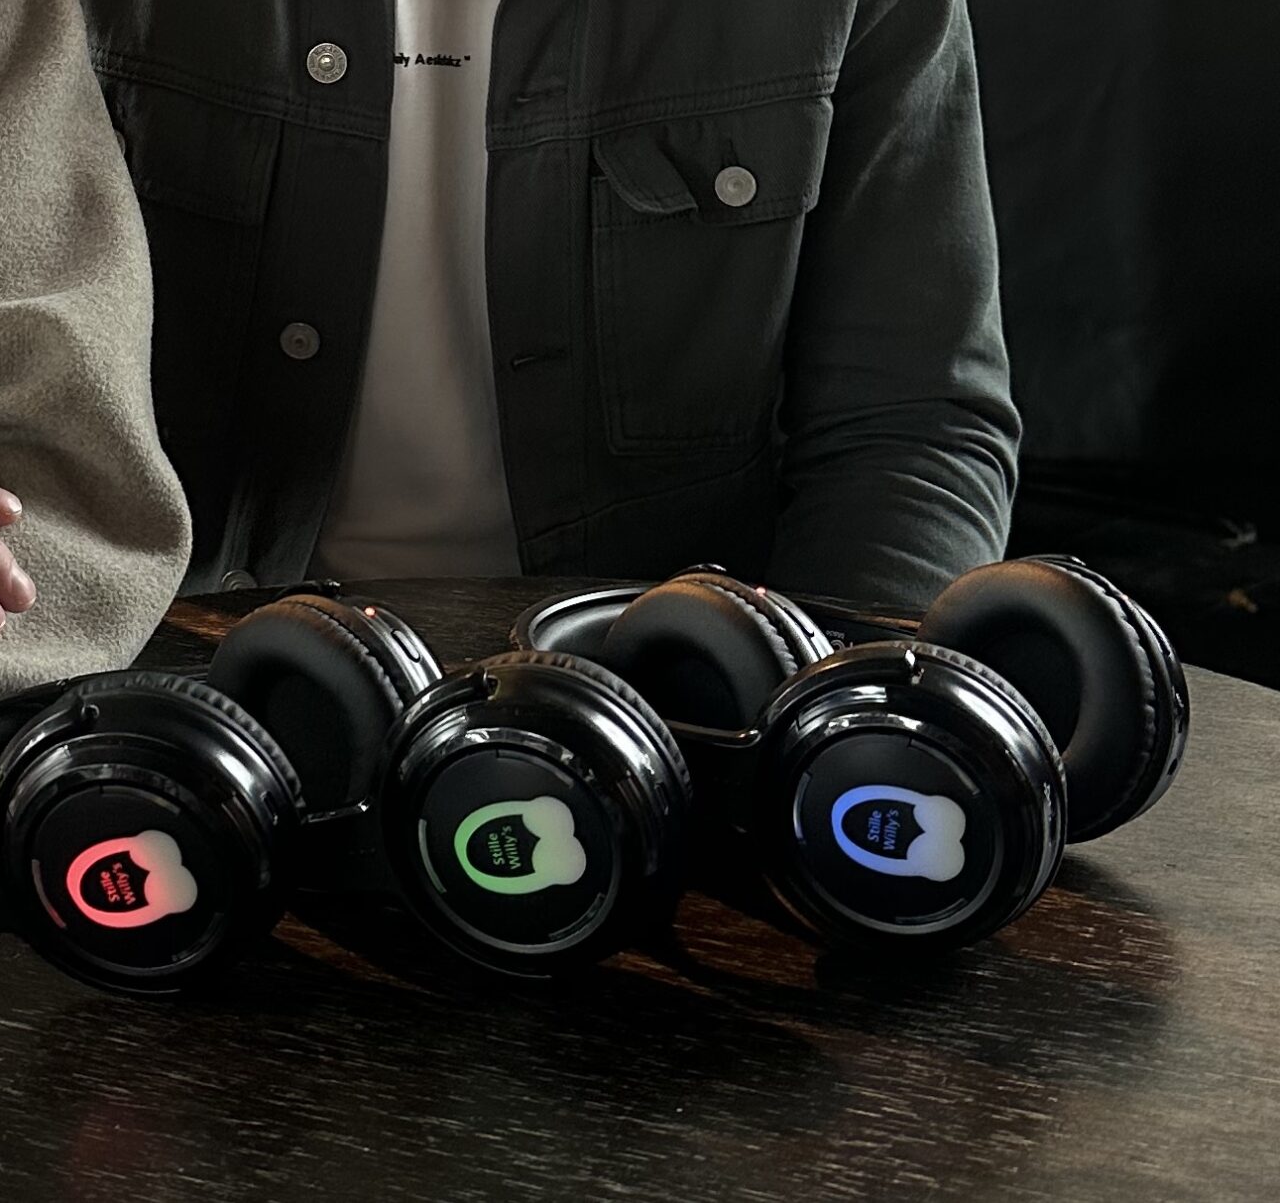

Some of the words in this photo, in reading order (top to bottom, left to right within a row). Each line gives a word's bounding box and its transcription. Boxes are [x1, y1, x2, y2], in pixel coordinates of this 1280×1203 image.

[867, 810, 883, 843] Stille
[883, 808, 901, 851] Willy's
[488, 833, 505, 866] Stille
[501, 825, 522, 870] Willy's
